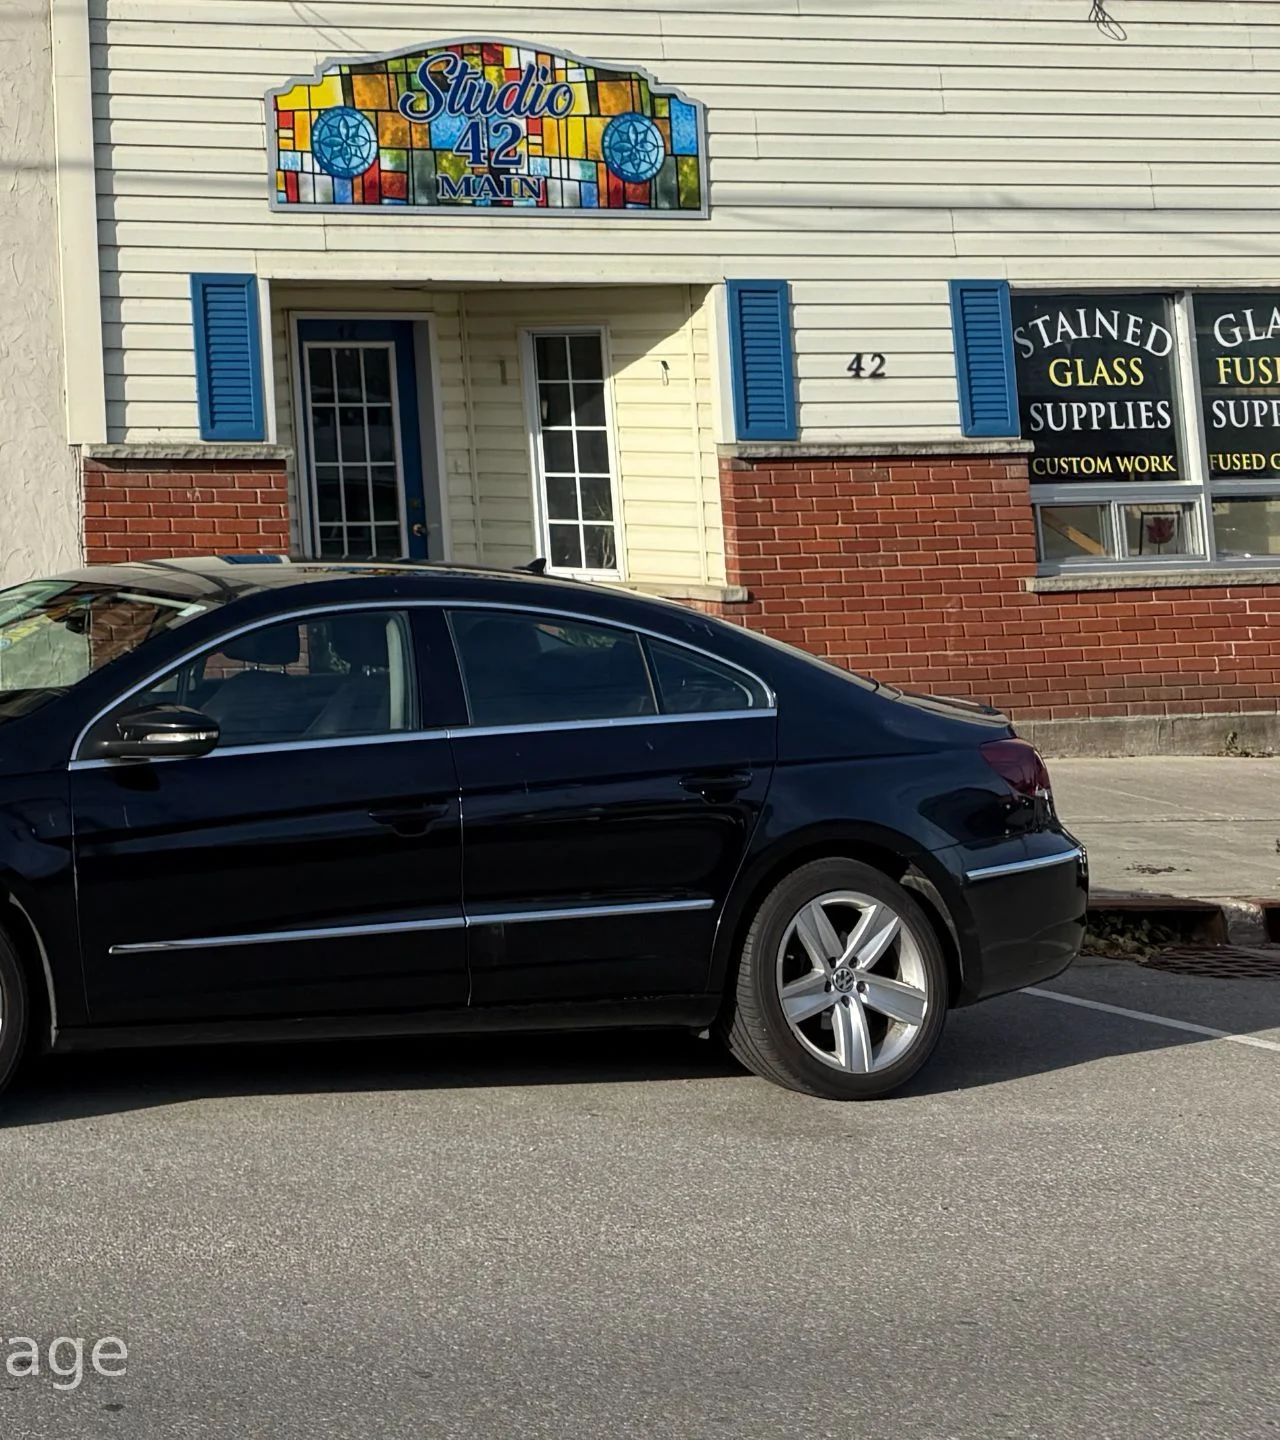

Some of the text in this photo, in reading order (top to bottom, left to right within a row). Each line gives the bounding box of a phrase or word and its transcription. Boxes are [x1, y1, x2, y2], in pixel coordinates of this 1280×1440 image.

[398, 53, 575, 121] Studio
[453, 119, 524, 168] 42
[437, 174, 545, 201] MAIN
[1014, 308, 1173, 359] STAINED
[847, 352, 887, 379] 42
[1048, 357, 1144, 387] GLASS
[1029, 400, 1172, 432] SUPPLIES
[1032, 455, 1177, 476] CUSTOM WORK
[1209, 453, 1266, 471] FUSED
